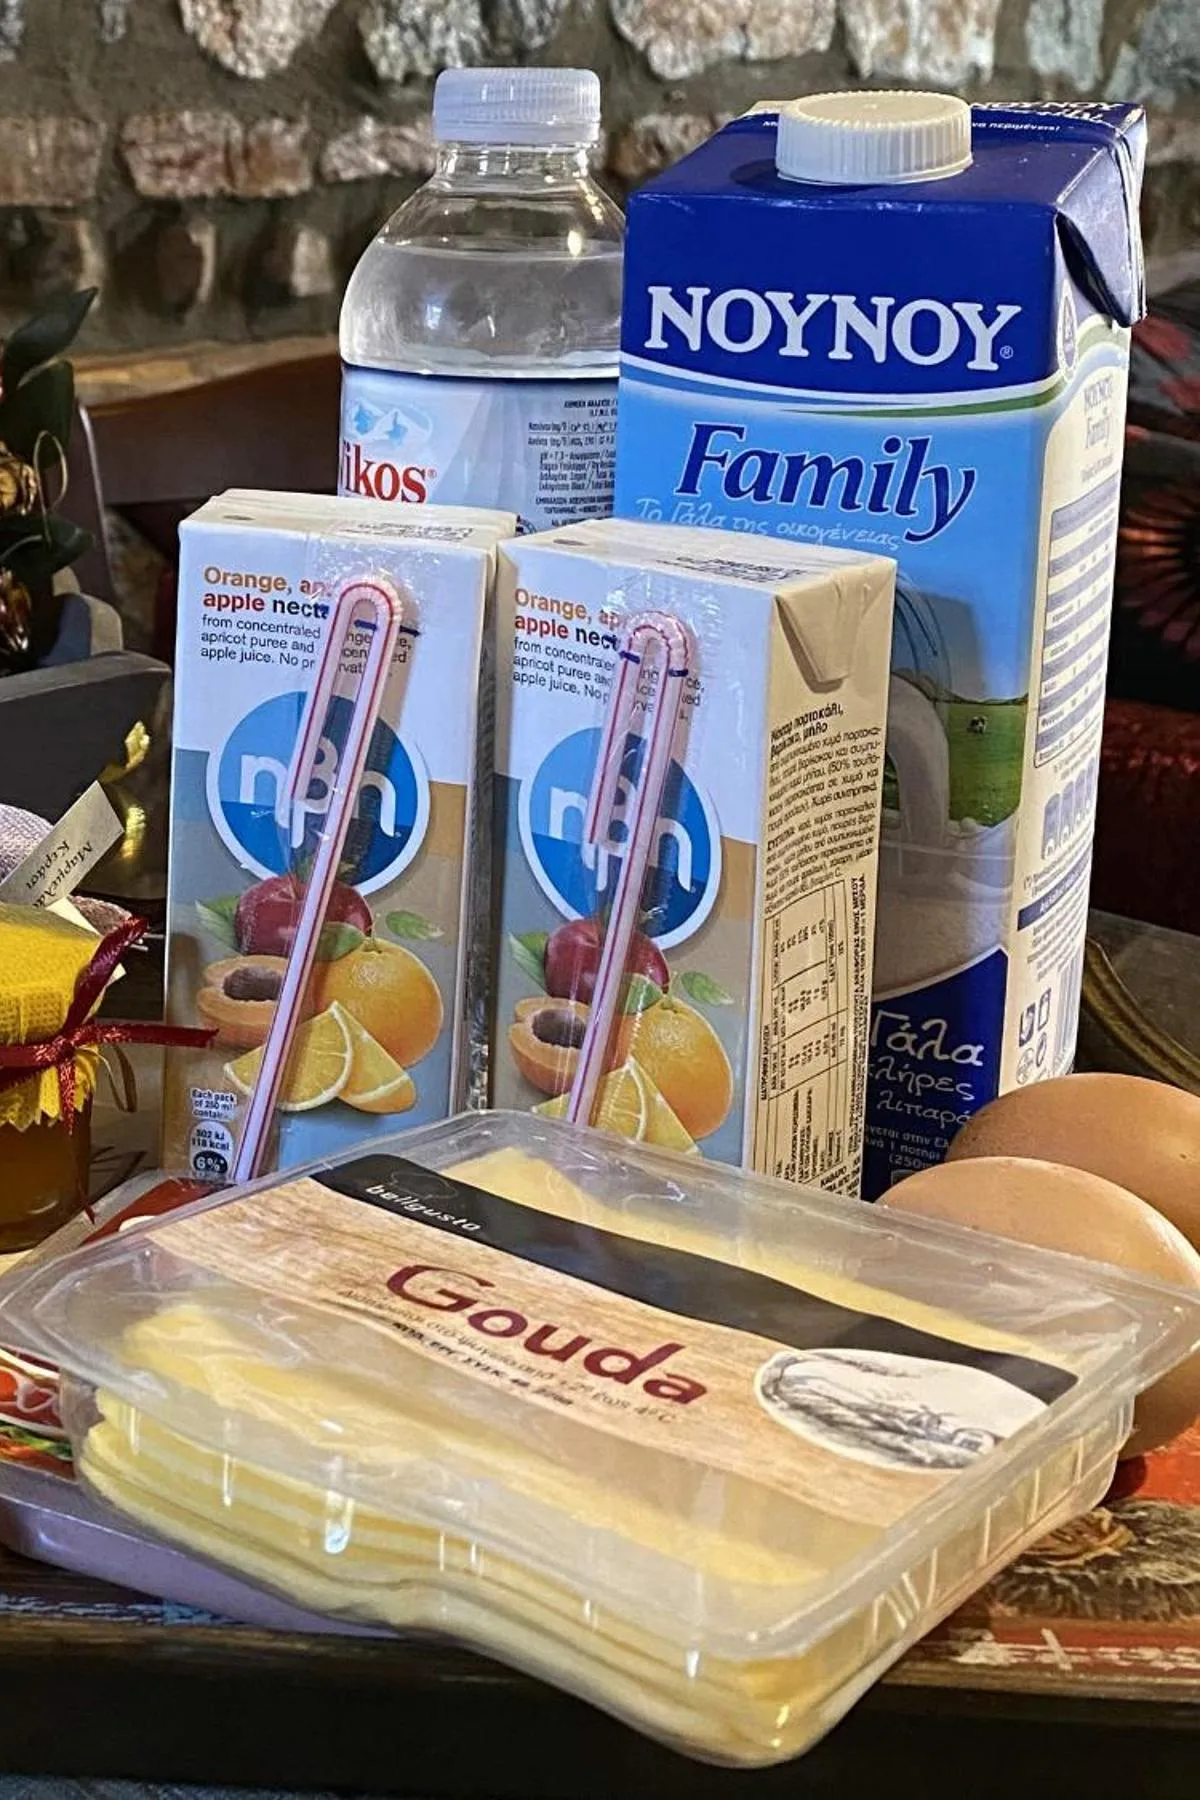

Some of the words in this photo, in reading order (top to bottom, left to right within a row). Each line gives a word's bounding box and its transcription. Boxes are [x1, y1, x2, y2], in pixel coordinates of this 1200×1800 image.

[643, 285, 1022, 372] NOYNOY
[341, 440, 427, 504] ikos
[675, 422, 978, 545] Family
[635, 497, 663, 522] Το
[669, 500, 729, 531] Γάλα
[732, 517, 770, 537] της
[775, 520, 902, 553] οικογένειας
[203, 565, 294, 595] Orange,
[203, 591, 266, 614] apple
[514, 588, 593, 626] Orange,
[201, 613, 234, 628] from
[514, 614, 570, 640] apple
[200, 630, 248, 648] apricot
[249, 635, 288, 652] puree
[291, 638, 315, 654] and
[200, 646, 237, 664] apple
[239, 647, 275, 665] juice.
[279, 652, 299, 667] No
[513, 637, 542, 653] from
[512, 653, 556, 674] apricot
[557, 665, 591, 681] puree
[512, 669, 547, 688] apple
[548, 675, 581, 696] juice.
[584, 683, 602, 700] No
[802, 722, 828, 742] μήλο
[870, 1009, 984, 1067] Γάλα
[868, 1055, 976, 1101] λήρες
[385, 1263, 708, 1406] Gouda
